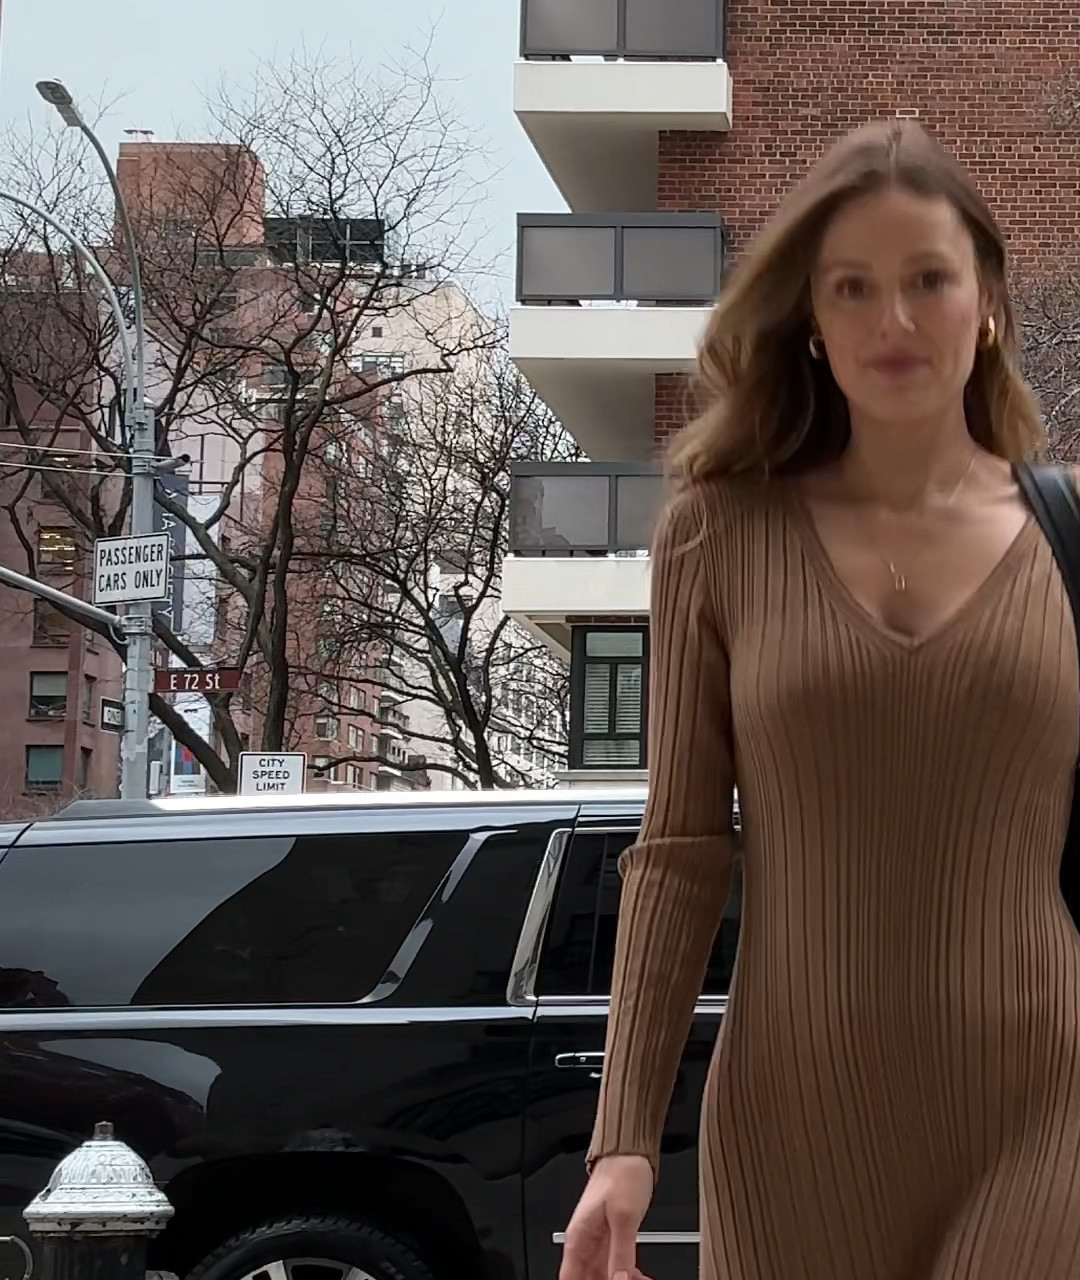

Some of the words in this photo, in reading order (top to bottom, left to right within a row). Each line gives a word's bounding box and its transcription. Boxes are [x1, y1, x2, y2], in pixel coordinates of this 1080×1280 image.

[99, 543, 164, 567] PASSENGER
[98, 572, 127, 592] CARS
[134, 568, 163, 589] ONLY
[170, 674, 177, 690] E
[183, 673, 199, 690] 72
[205, 672, 220, 689] St
[258, 758, 285, 768] CITY
[252, 770, 291, 780] SPEED
[256, 782, 287, 792] LIMIT
